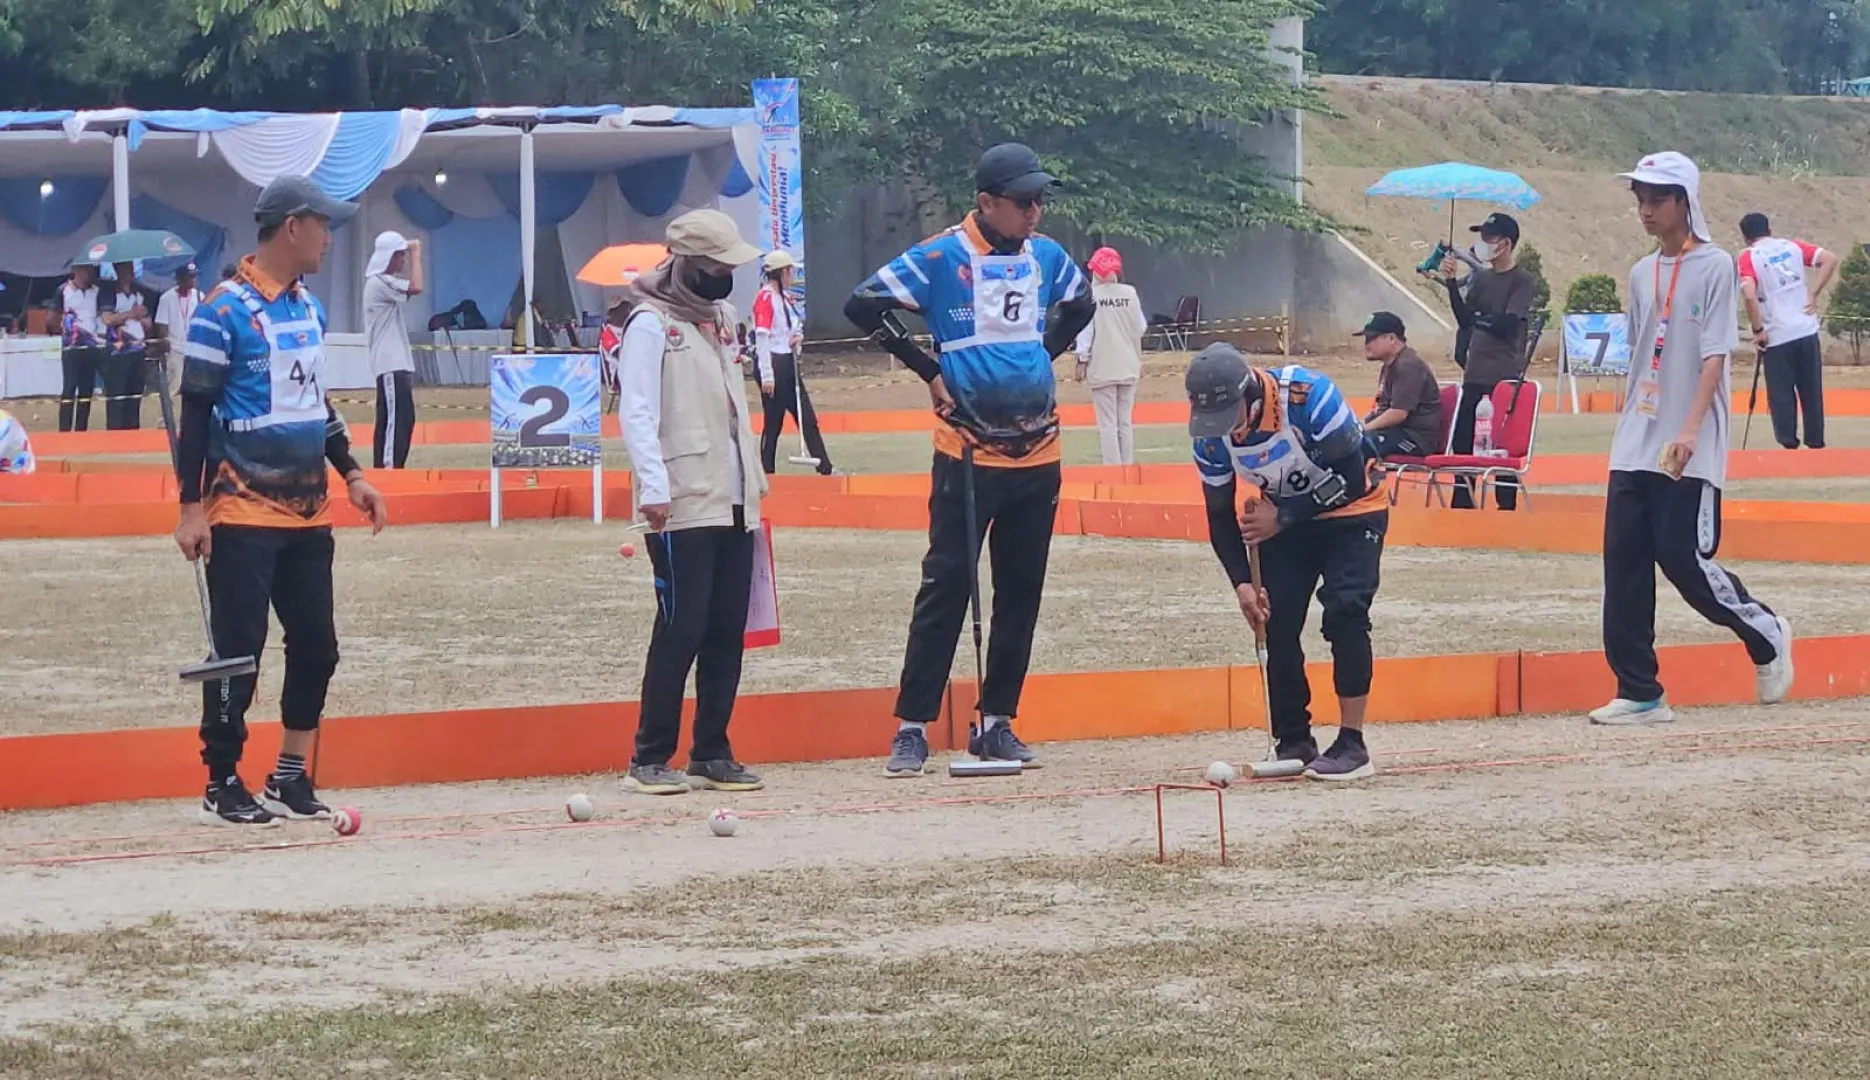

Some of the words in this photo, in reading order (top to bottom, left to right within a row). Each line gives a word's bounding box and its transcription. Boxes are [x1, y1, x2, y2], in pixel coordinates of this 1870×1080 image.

[778, 166, 791, 248] Mendunia!
[1003, 290, 1025, 322] 6
[1099, 298, 1130, 307] WASIT
[1584, 332, 1610, 367] 7
[518, 384, 571, 448] 2
